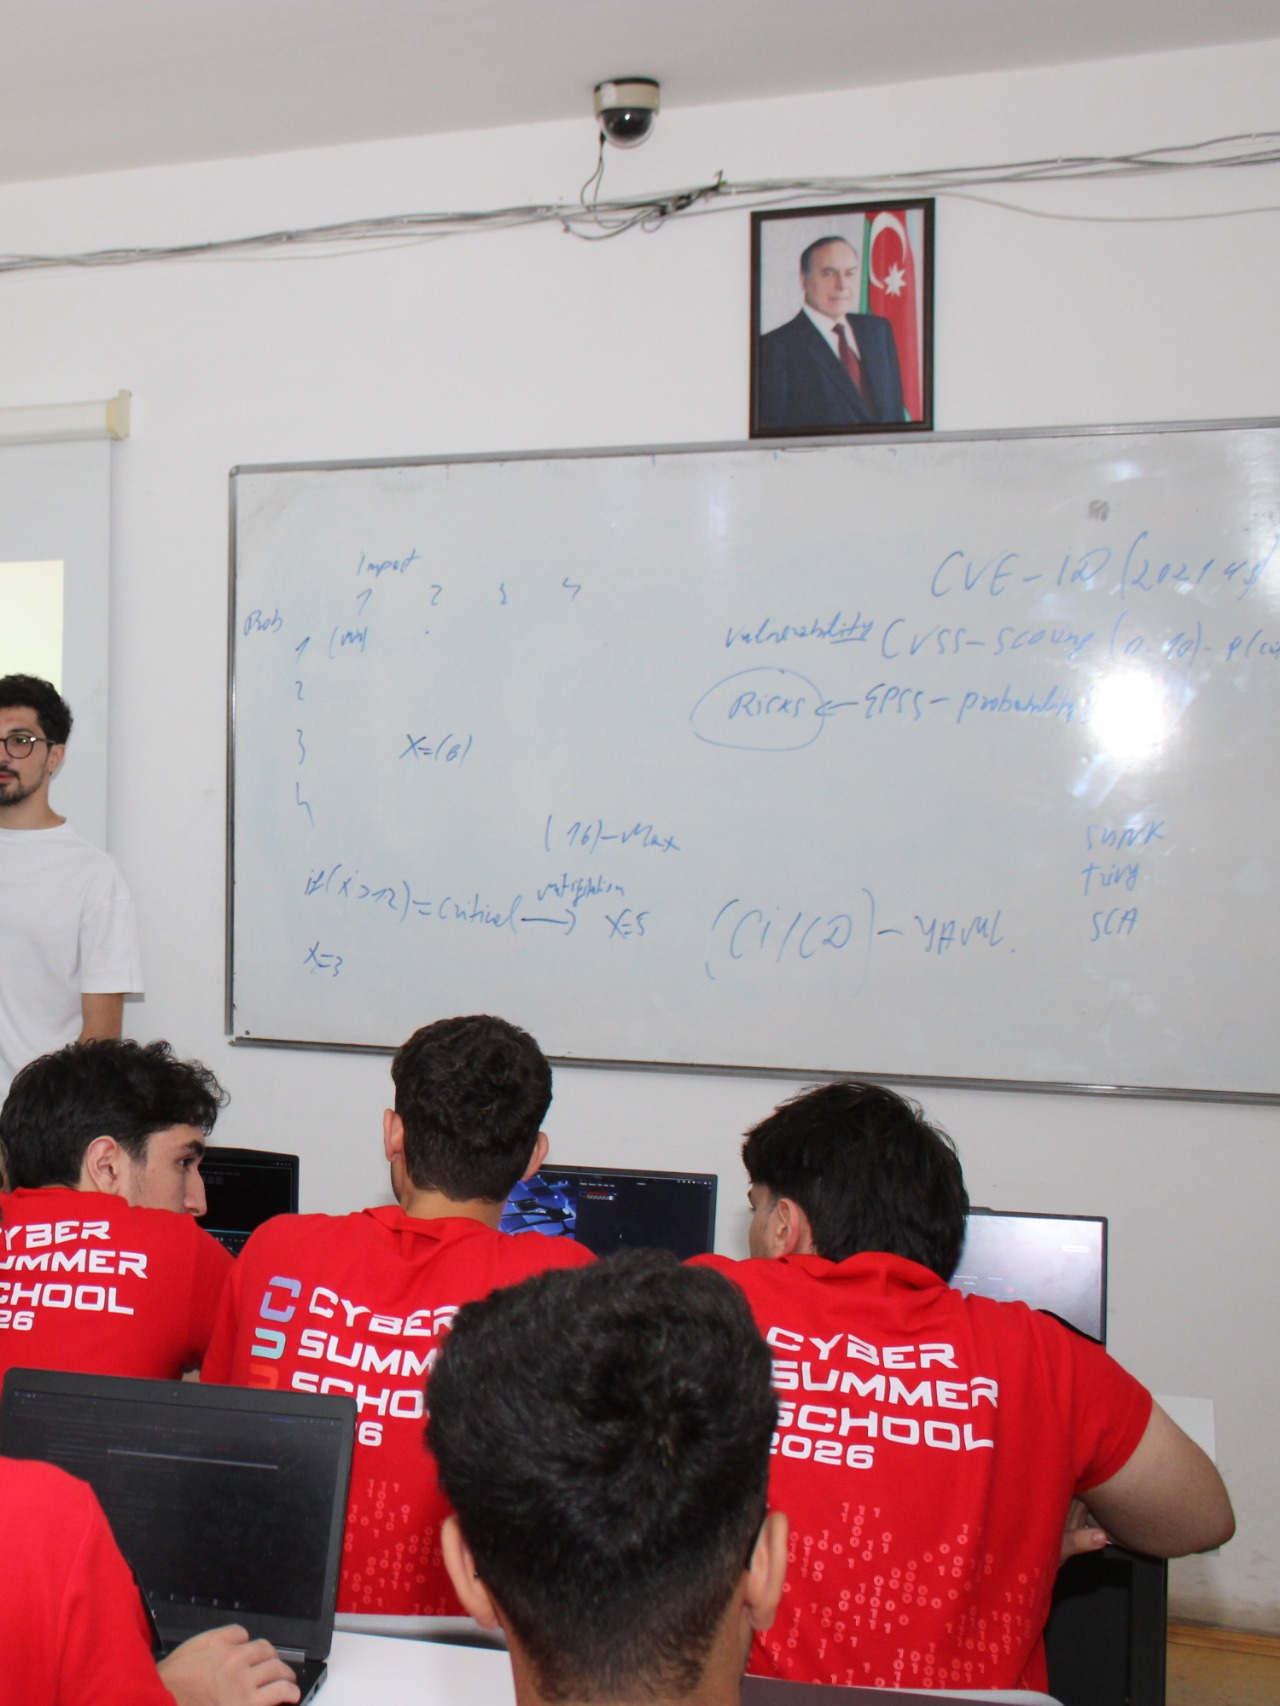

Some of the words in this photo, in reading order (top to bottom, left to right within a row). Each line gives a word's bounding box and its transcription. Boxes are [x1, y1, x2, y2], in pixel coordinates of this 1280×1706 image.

[297, 1328, 438, 1377] SUMM
[765, 1326, 959, 1370] CYBER
[770, 1360, 999, 1410] SUMMER
[777, 1401, 995, 1452] SCHOOL
